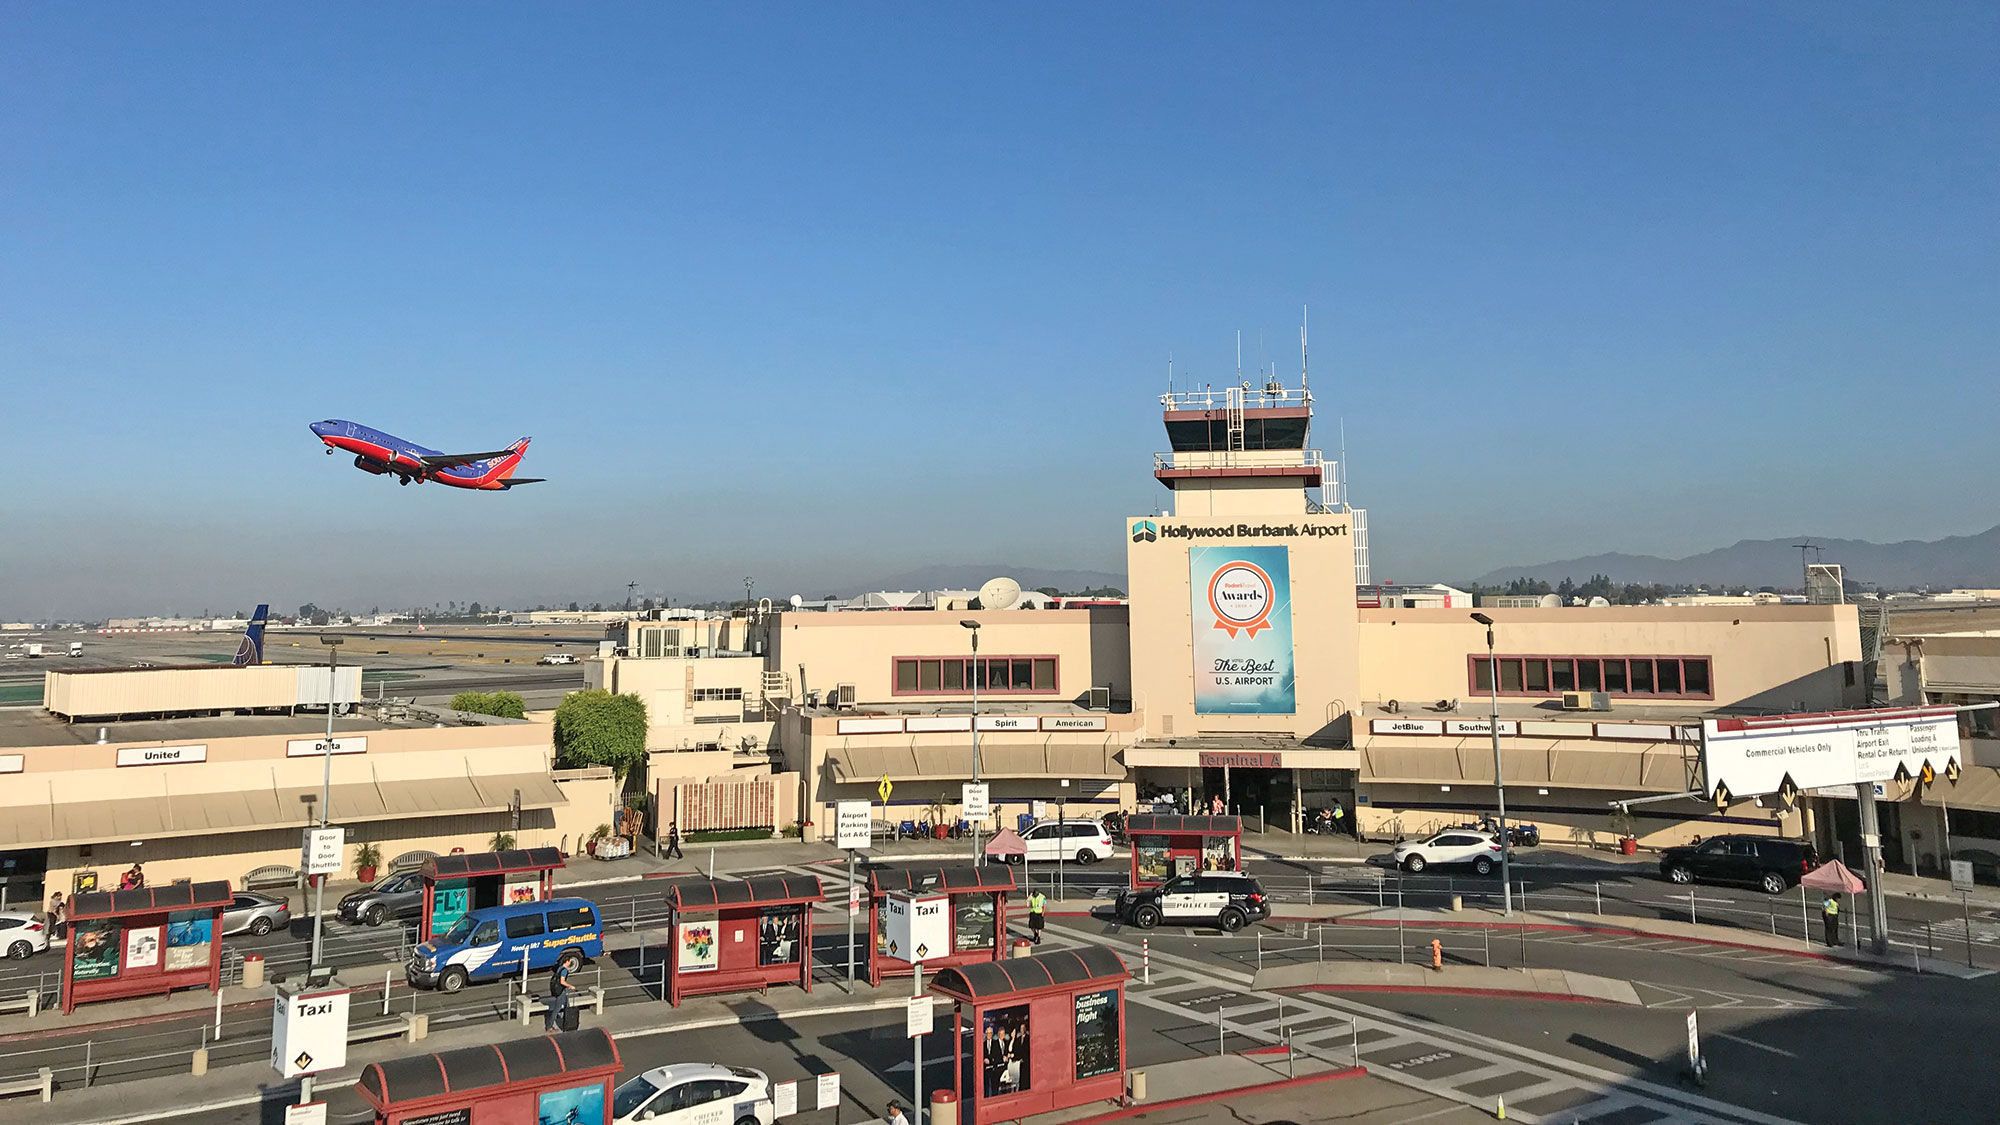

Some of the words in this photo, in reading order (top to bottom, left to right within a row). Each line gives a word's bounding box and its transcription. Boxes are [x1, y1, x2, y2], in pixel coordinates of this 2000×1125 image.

[1161, 525, 1234, 540] Hollywood
[1237, 524, 1299, 537] Burbank
[1300, 524, 1347, 539] Airport
[1220, 590, 1262, 600] Awards
[1215, 659, 1239, 671] The
[1241, 659, 1274, 674] Best
[1215, 677, 1232, 685] U.S.
[1235, 677, 1273, 685] AIRPORT
[995, 720, 1018, 728] Spirit
[1392, 723, 1425, 731] JetBlue
[1458, 723, 1505, 732] Southwst
[1857, 739, 1877, 749] Airport
[1878, 739, 1889, 747] Exit
[1911, 736, 1931, 744] Loading
[315, 742, 341, 751] Deta
[1746, 747, 1786, 758] Commercial
[1788, 745, 1815, 754] Vehicles
[1817, 743, 1832, 752] Only
[1912, 746, 1938, 754] Unloading
[144, 750, 180, 760] United
[1857, 751, 1876, 759] Rental
[1877, 749, 1888, 758] Car
[1889, 748, 1907, 756] Return
[1200, 753, 1263, 766] Terminal
[1271, 753, 1281, 766] A
[311, 861, 341, 869] Shuttles
[889, 902, 905, 916] Taxi
[916, 904, 939, 916] Taxi
[543, 933, 597, 948] SuperShuttle
[276, 999, 286, 1016] Taxi
[1076, 996, 1108, 1009] business
[297, 1001, 332, 1017] Taxi
[1076, 1011, 1097, 1025] flight
[694, 1110, 724, 1121] CHECKER
